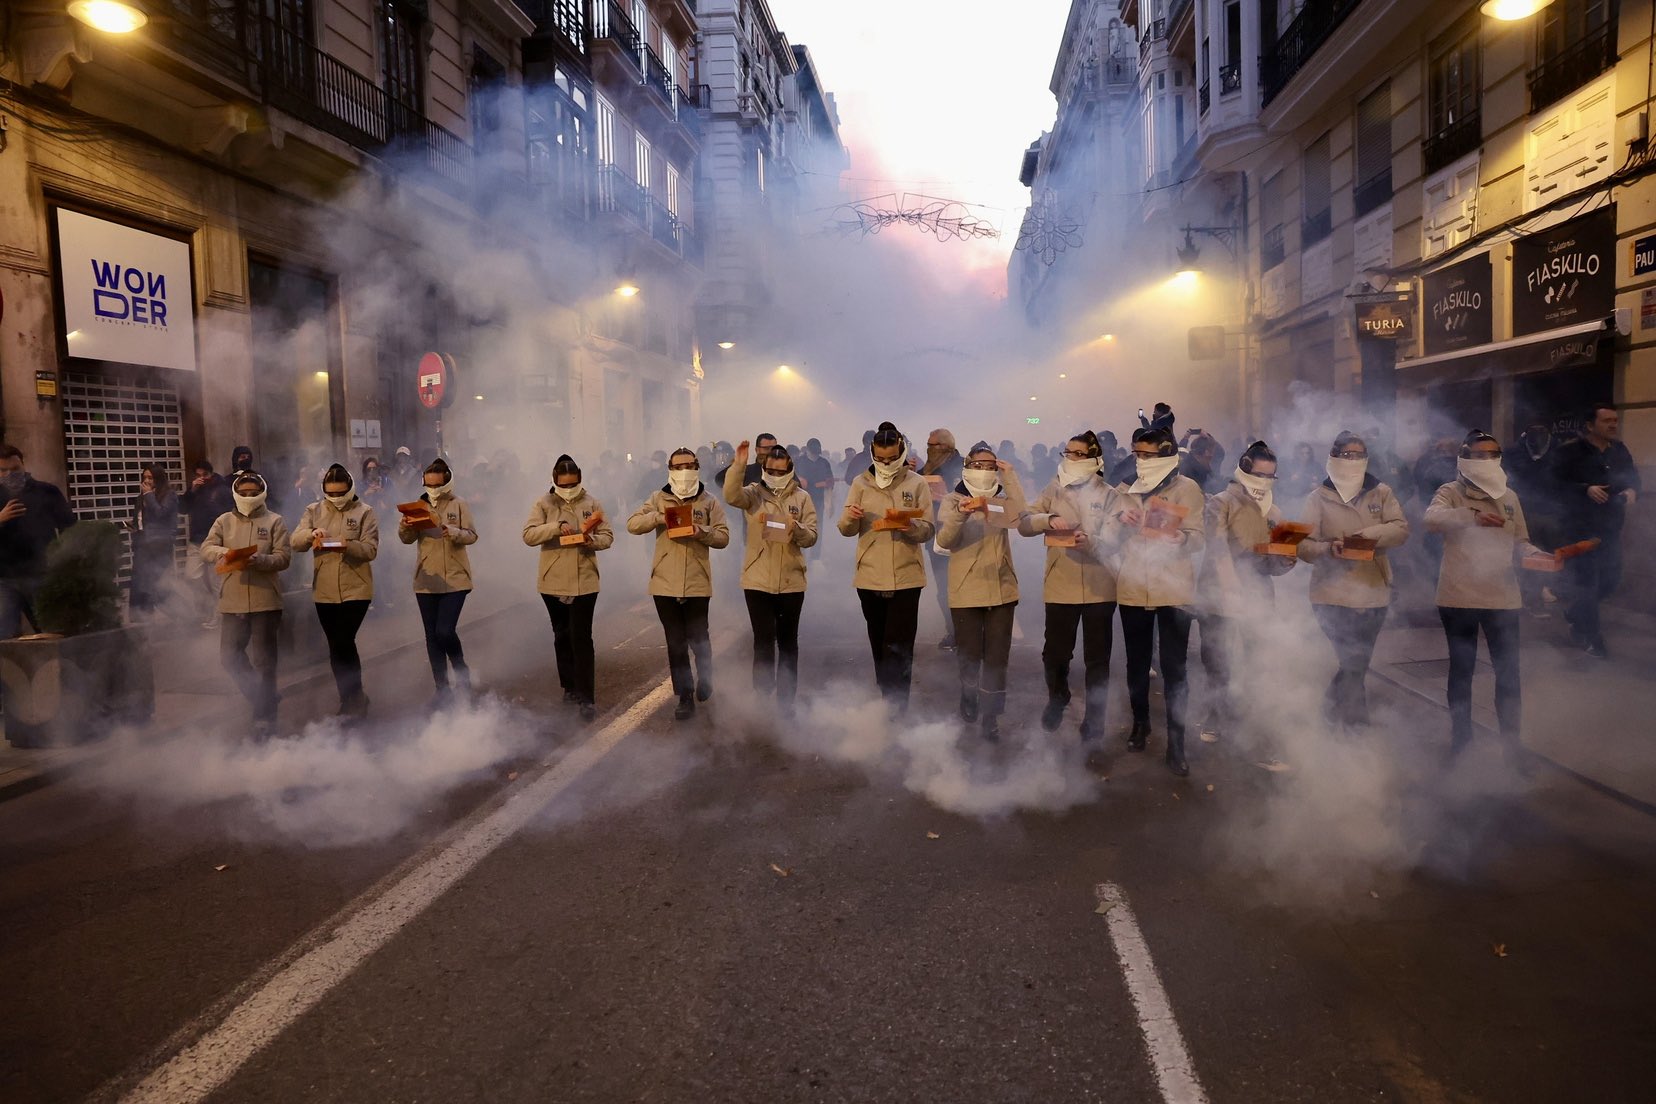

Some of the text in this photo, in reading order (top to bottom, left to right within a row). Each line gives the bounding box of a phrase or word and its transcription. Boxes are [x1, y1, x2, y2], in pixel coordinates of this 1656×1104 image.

[1527, 253, 1600, 292] FIASKILO
[1635, 250, 1654, 269] PAU
[91, 259, 166, 299] WON
[92, 289, 167, 326] DER
[1364, 318, 1405, 331] TURIA
